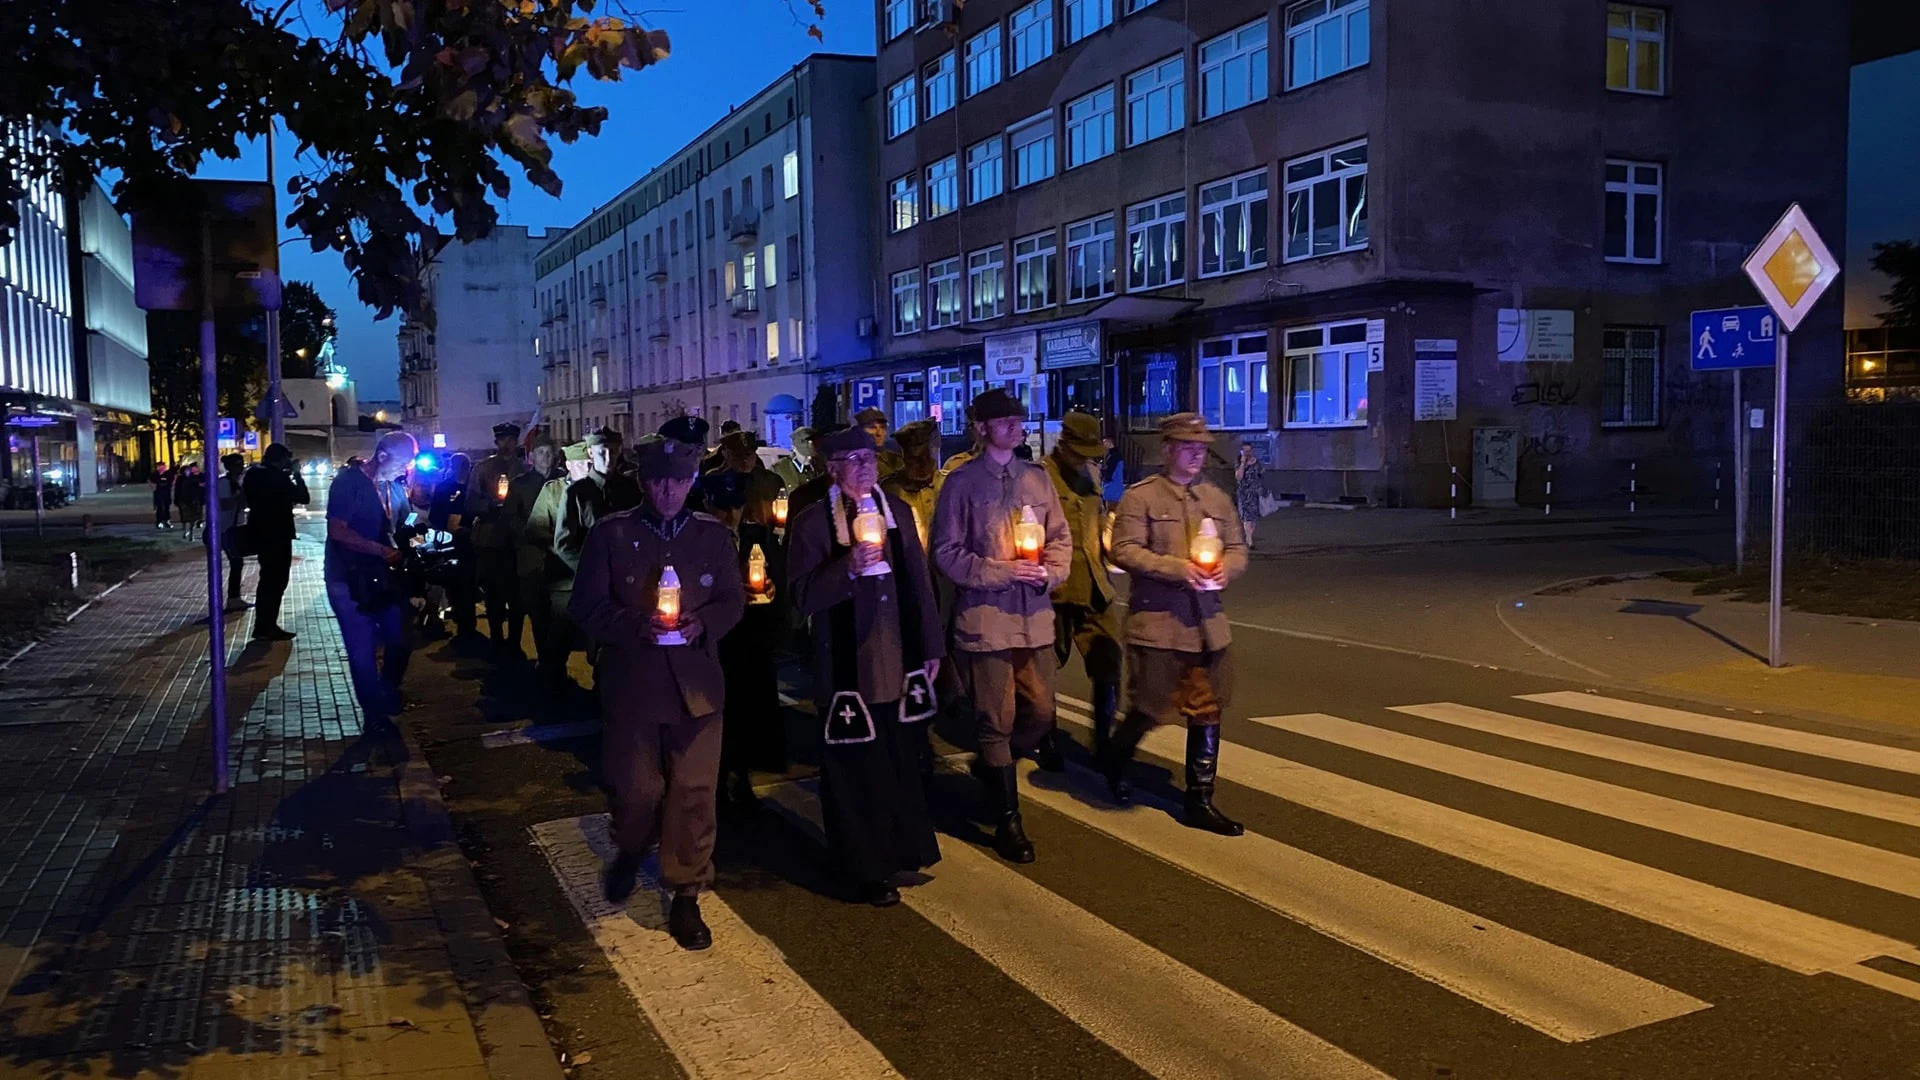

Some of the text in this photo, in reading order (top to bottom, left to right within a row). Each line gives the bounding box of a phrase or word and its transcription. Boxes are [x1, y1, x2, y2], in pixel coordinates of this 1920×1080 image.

[1372, 347, 1380, 364] 5
[931, 370, 939, 393] P
[858, 383, 873, 404] P
[219, 420, 231, 434] P
[247, 433, 255, 442] P
